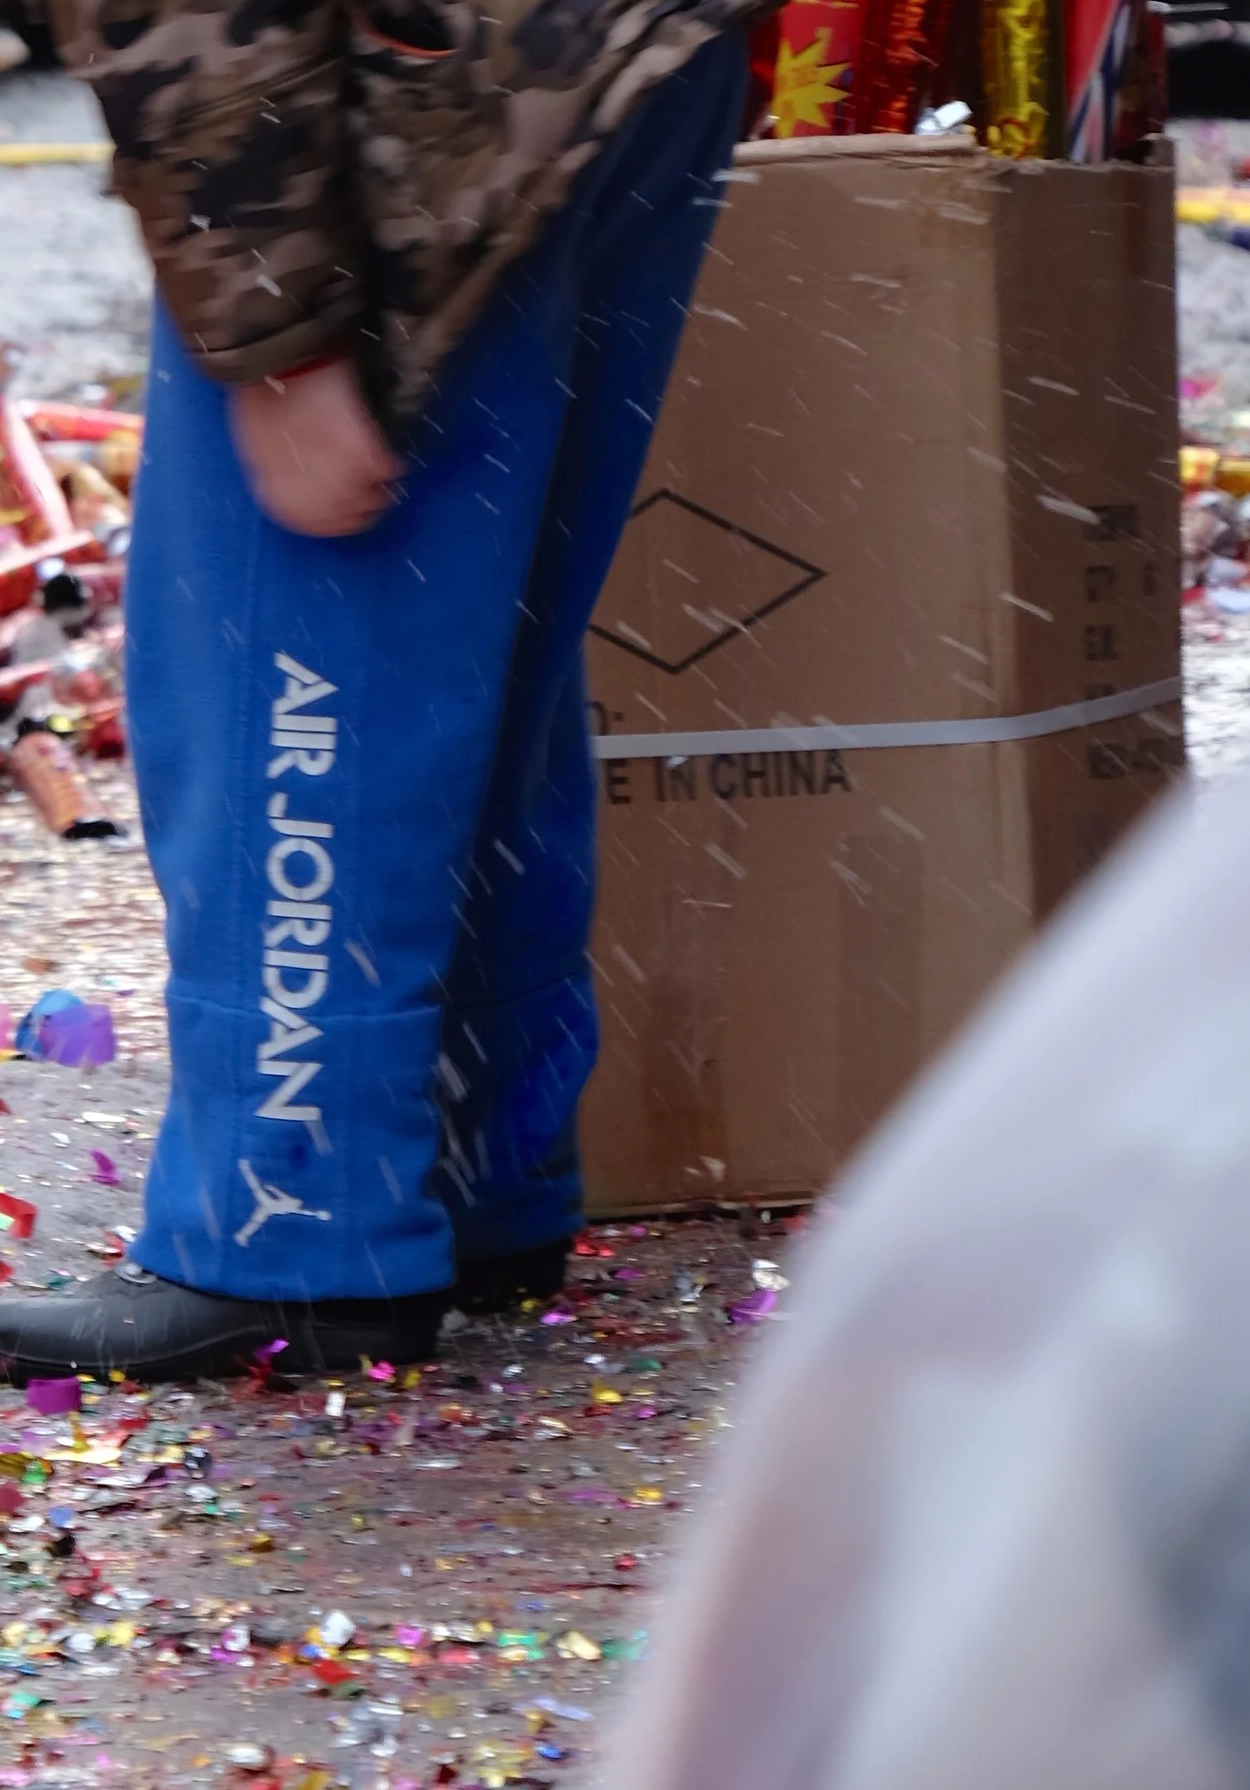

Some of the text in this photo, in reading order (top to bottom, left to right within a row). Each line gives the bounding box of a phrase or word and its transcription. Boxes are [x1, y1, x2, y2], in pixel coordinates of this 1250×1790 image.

[254, 650, 340, 1122] AIR JORDAN
[653, 755, 697, 802] IN
[708, 748, 852, 800] CHINA
